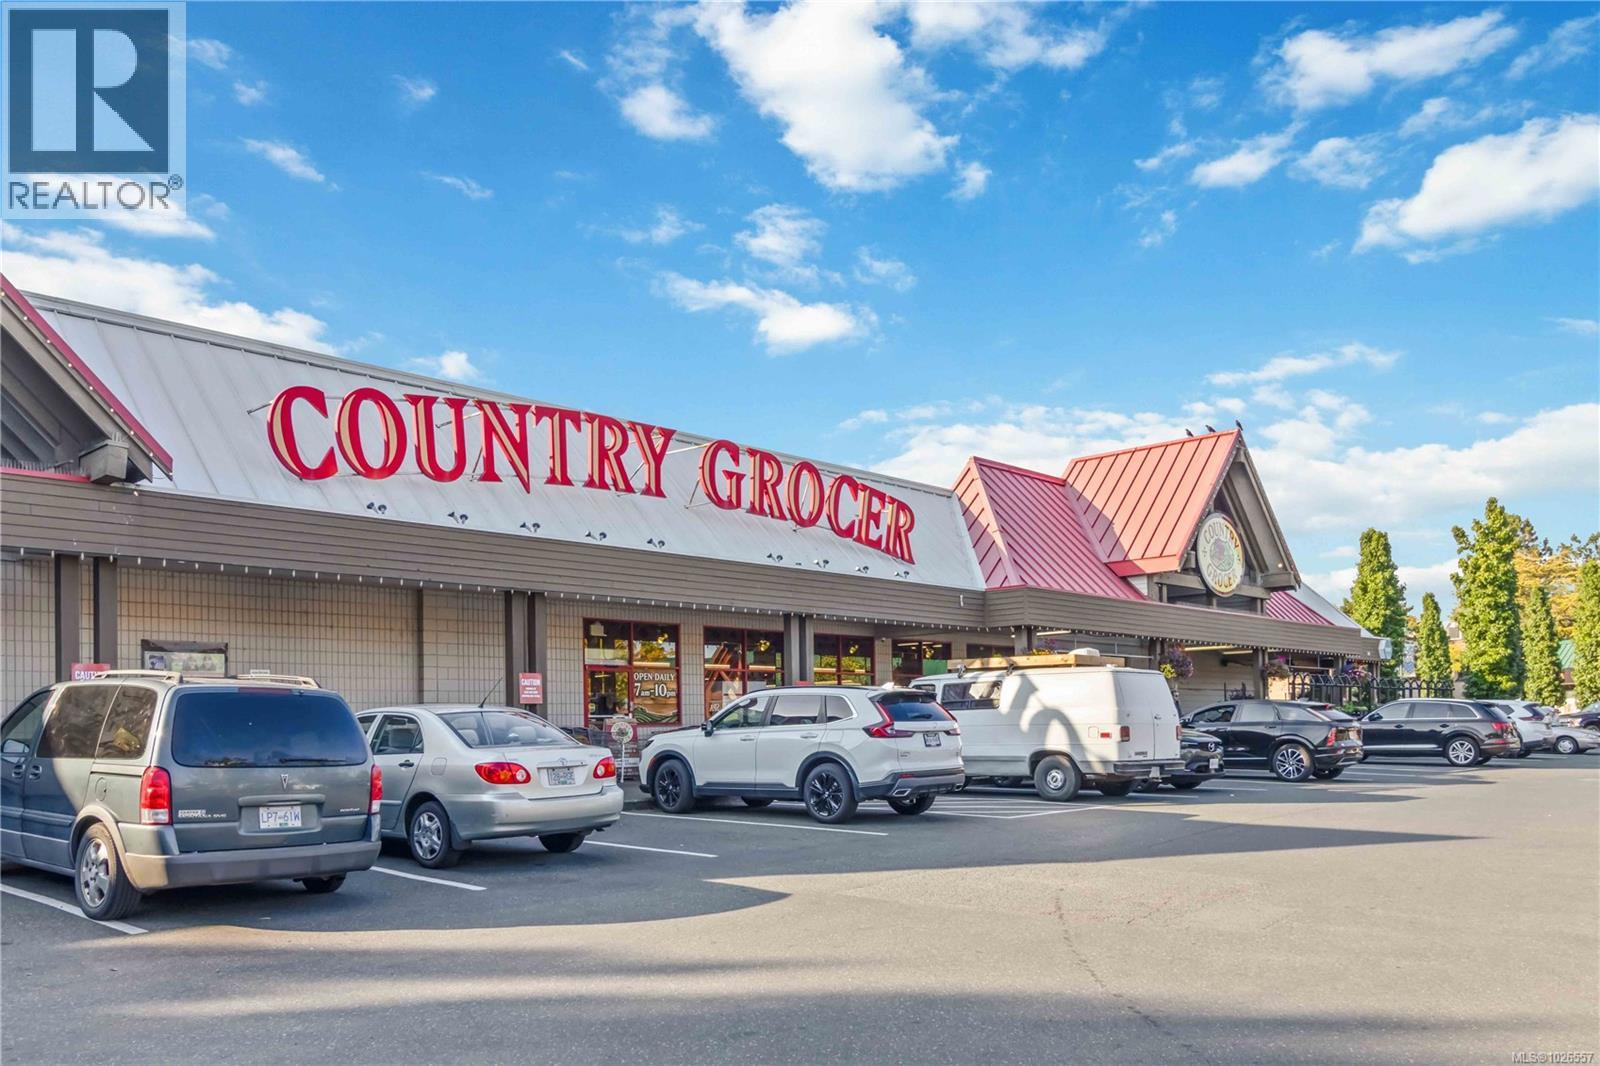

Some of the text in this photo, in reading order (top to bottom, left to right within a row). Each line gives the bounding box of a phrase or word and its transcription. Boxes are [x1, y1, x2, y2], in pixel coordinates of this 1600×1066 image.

[267, 385, 915, 565] COUNTRY GROCER
[633, 672, 675, 681] OPEN DAILY
